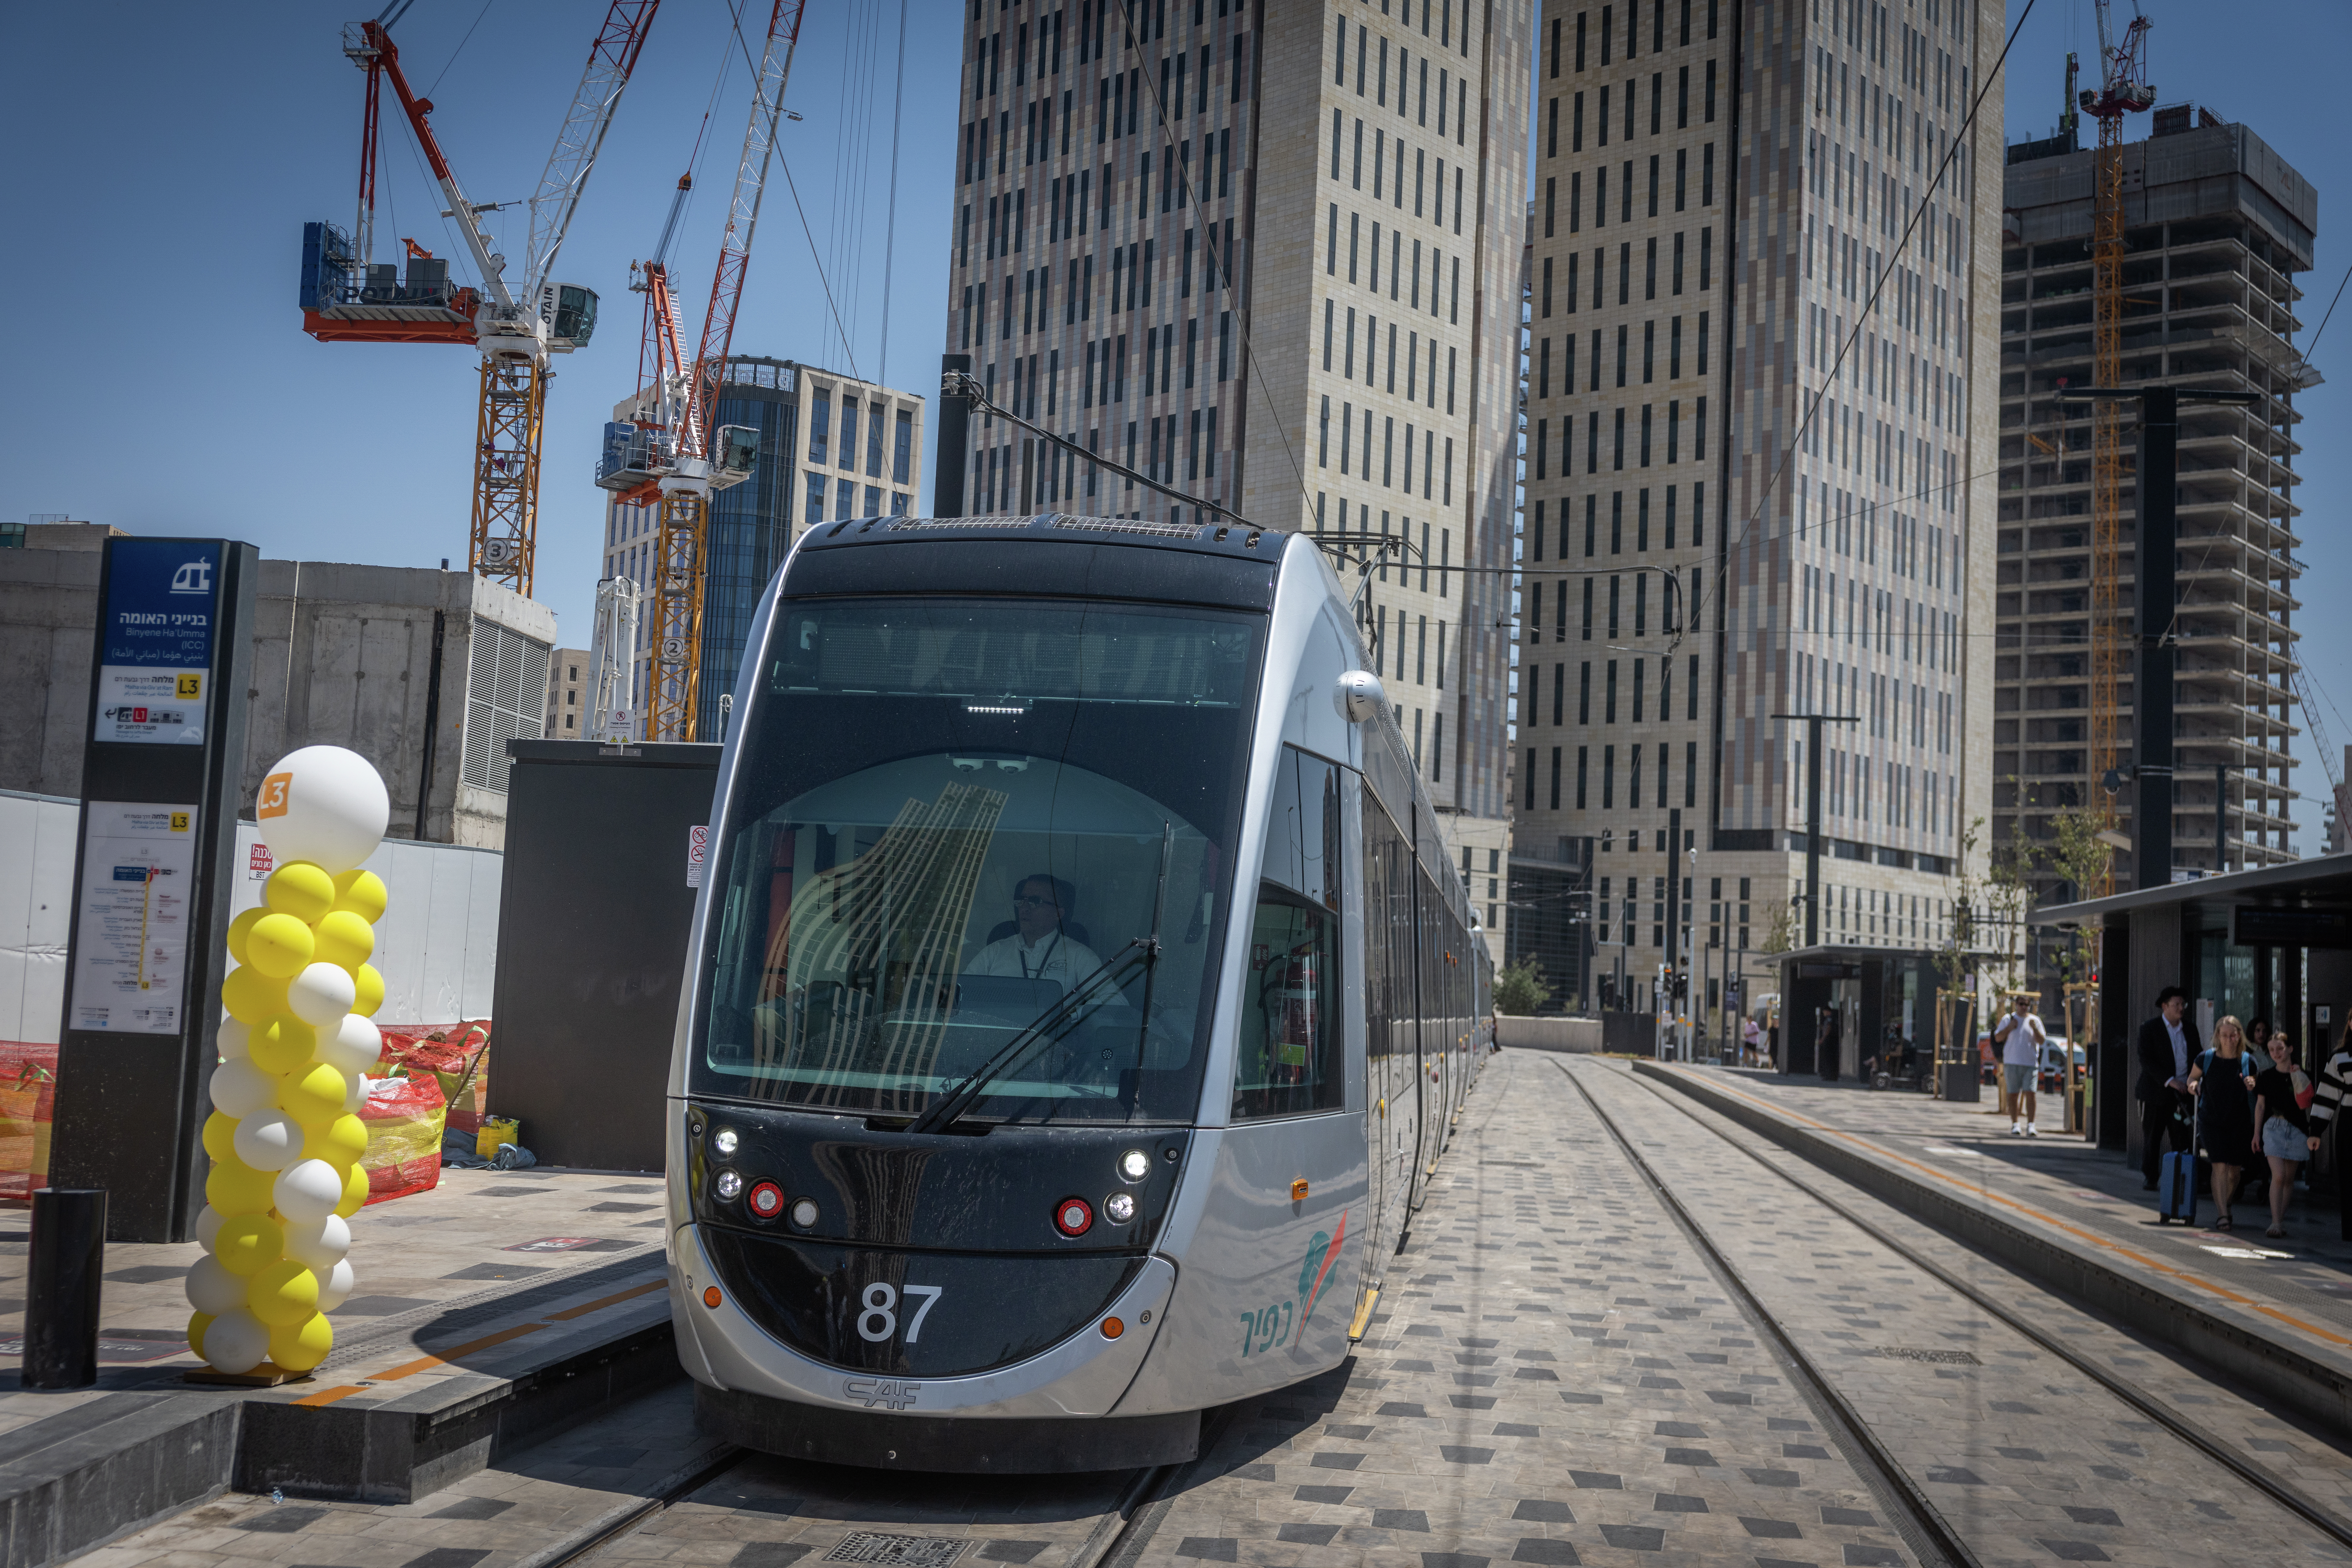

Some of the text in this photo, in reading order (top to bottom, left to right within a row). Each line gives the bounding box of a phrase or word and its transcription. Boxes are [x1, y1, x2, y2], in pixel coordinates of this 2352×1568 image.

[543, 287, 553, 333] OTAIN
[490, 543, 501, 557] 3
[120, 613, 207, 626] בנייני האומה
[126, 628, 205, 638] Binyene Ha'Umma
[182, 641, 204, 650] (ICC)
[669, 642, 677, 653] 2
[179, 679, 198, 694] L3
[135, 711, 144, 719] L1
[260, 781, 285, 809] L3
[172, 817, 187, 828] L3
[857, 1282, 942, 1343] 87
[1240, 1300, 1293, 1358] כפיר
[843, 1376, 921, 1410] CAF
